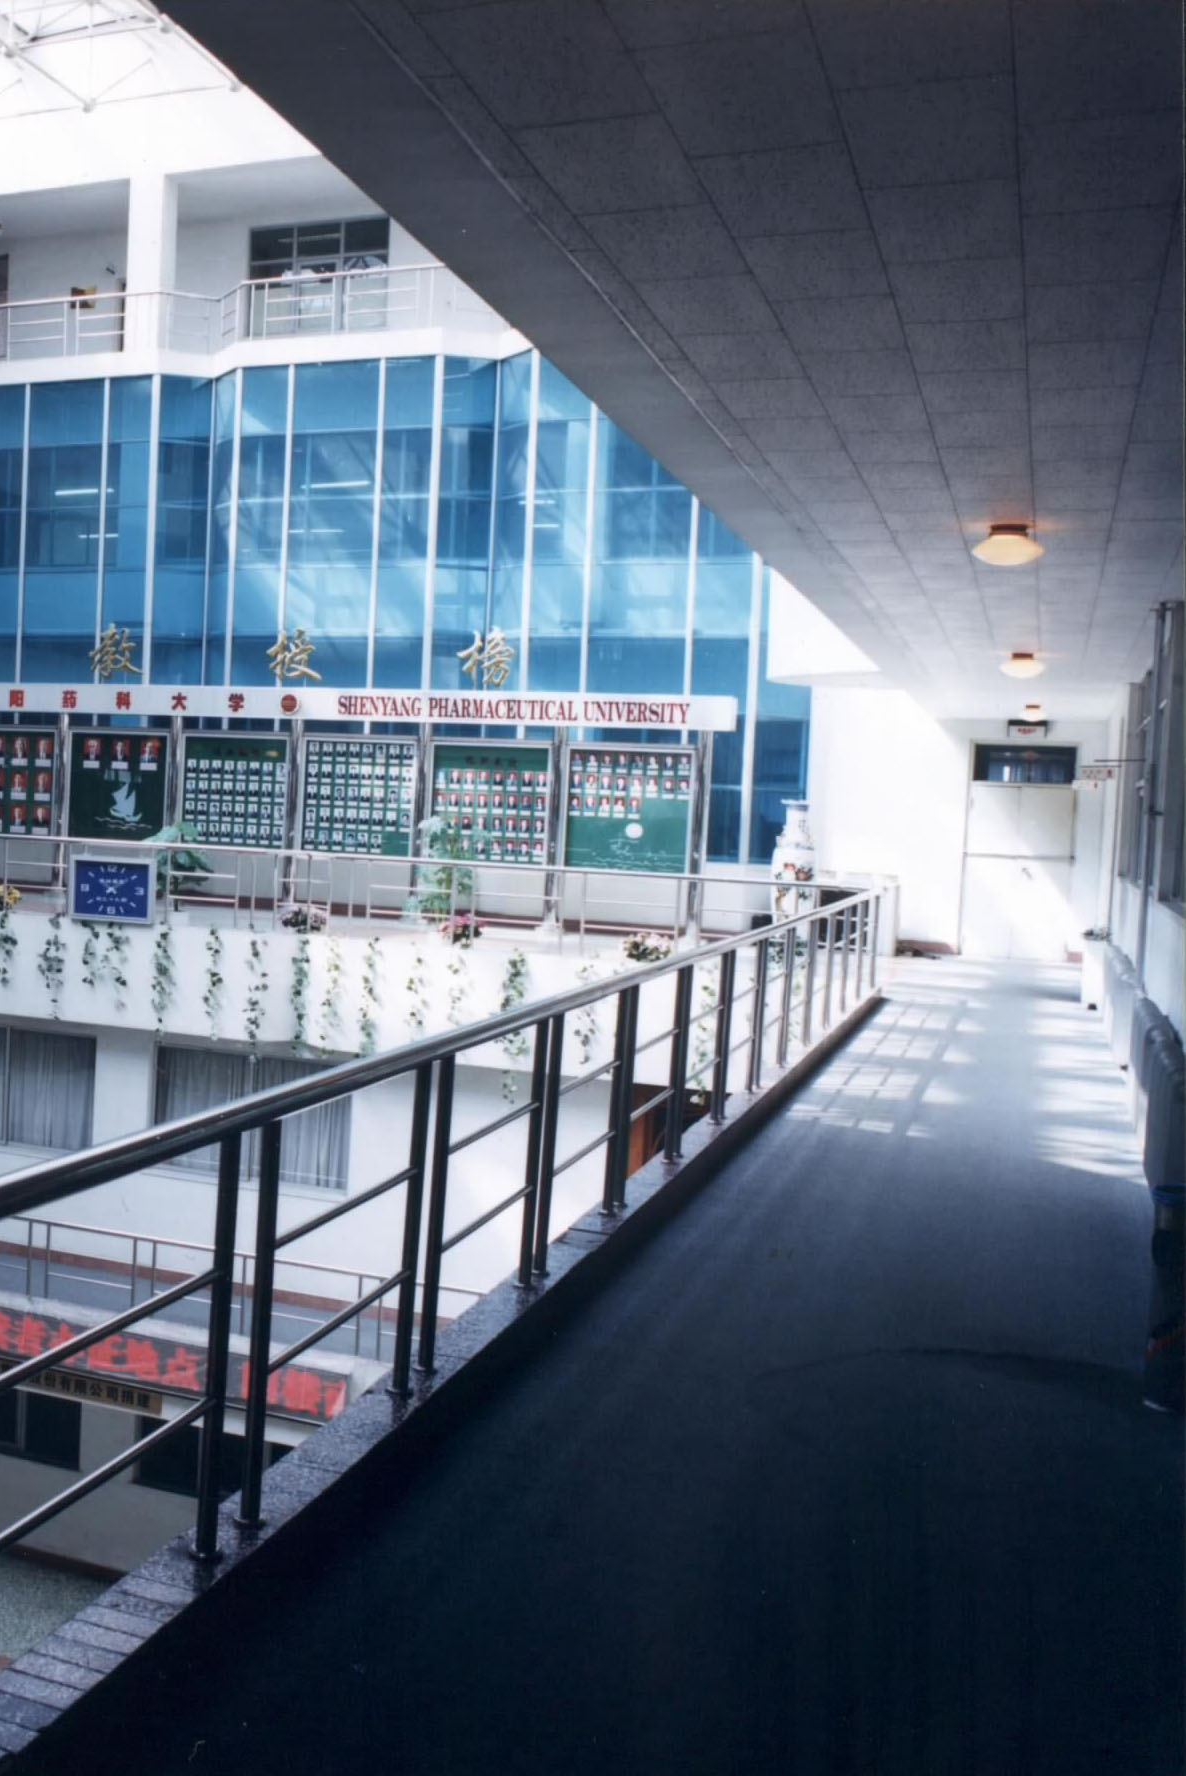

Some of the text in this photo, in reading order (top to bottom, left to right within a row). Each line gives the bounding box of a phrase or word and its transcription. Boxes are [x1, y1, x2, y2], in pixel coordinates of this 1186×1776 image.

[337, 695, 690, 724] SHENYANG PHARMACEUTICAL UNIVERSITY
[133, 887, 145, 896] 3
